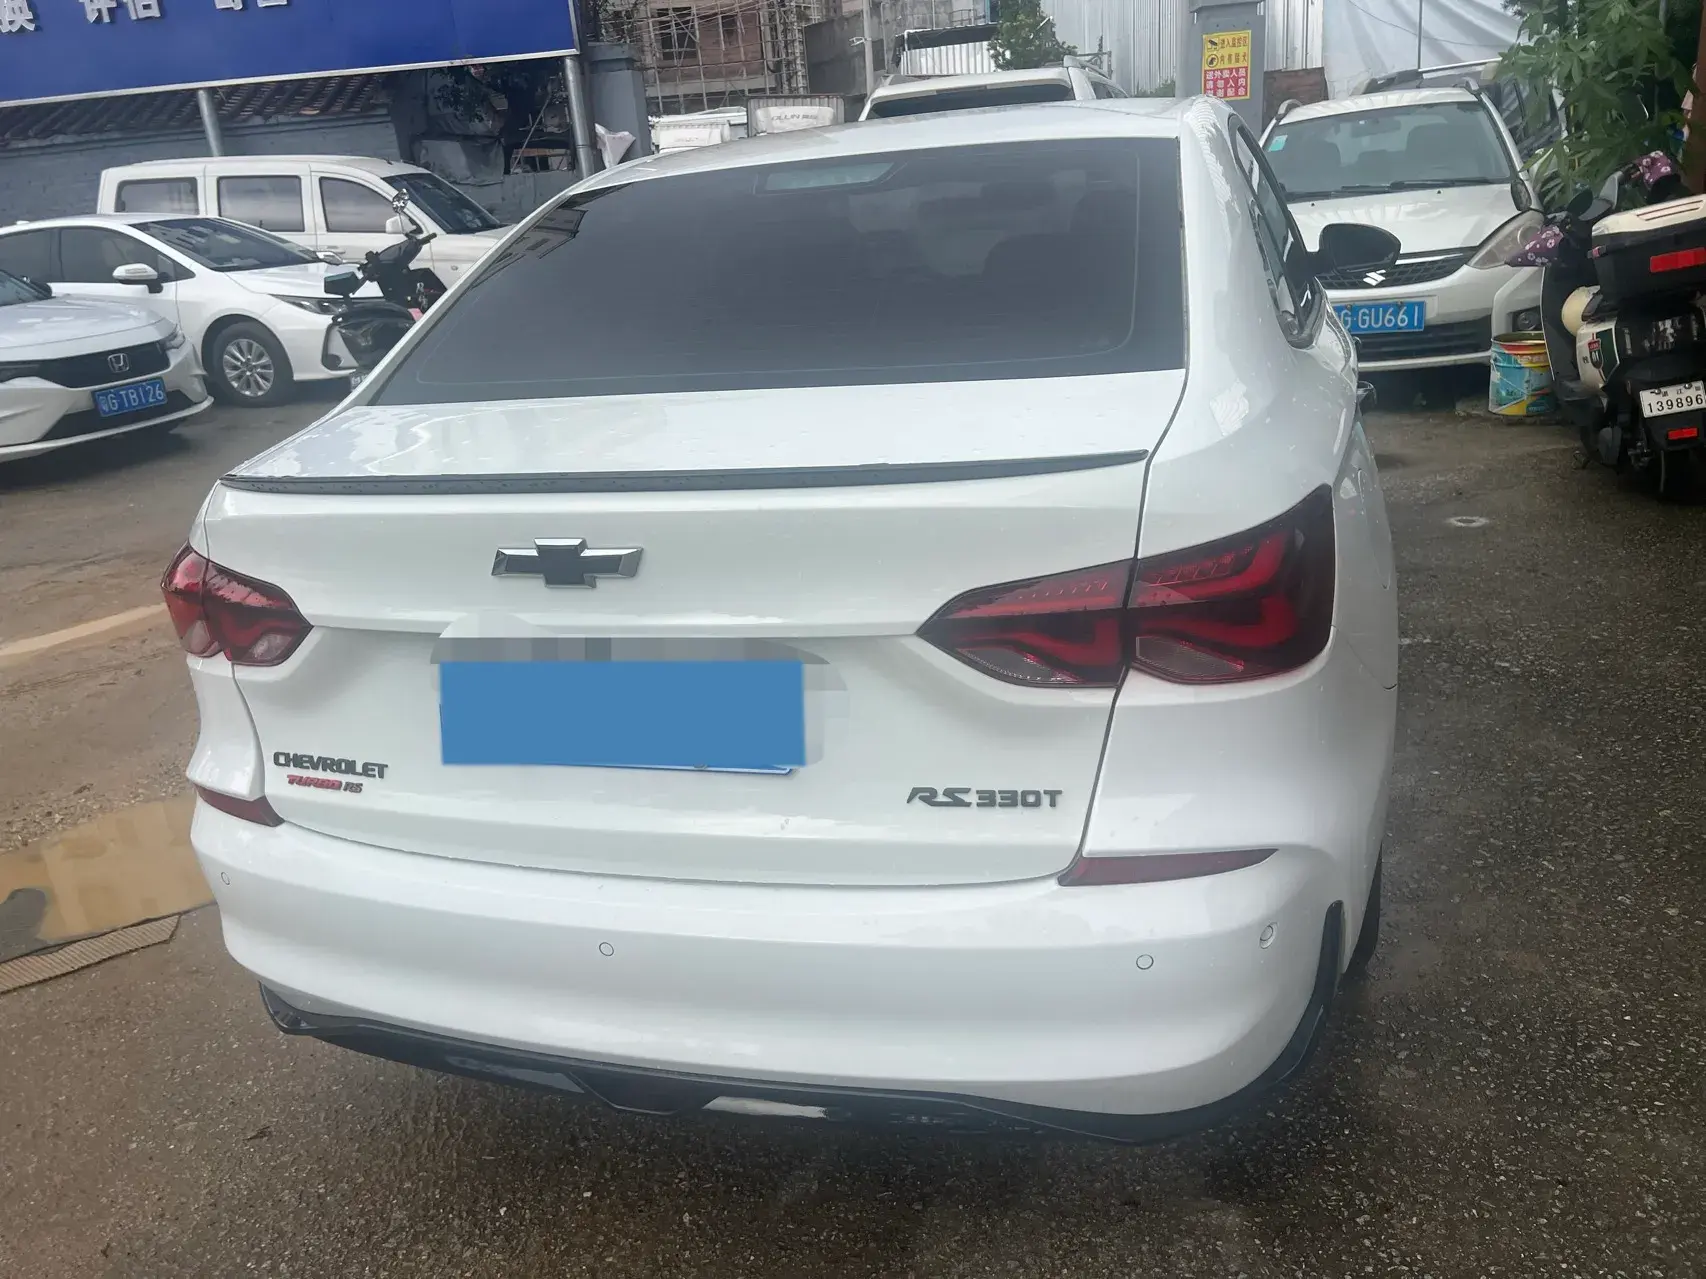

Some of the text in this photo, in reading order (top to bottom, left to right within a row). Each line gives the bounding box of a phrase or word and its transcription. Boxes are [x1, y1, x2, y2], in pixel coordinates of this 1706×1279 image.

[1337, 305, 1418, 330] G·GU661
[1647, 394, 1704, 413] 139896
[273, 751, 388, 779] CHEVROLET
